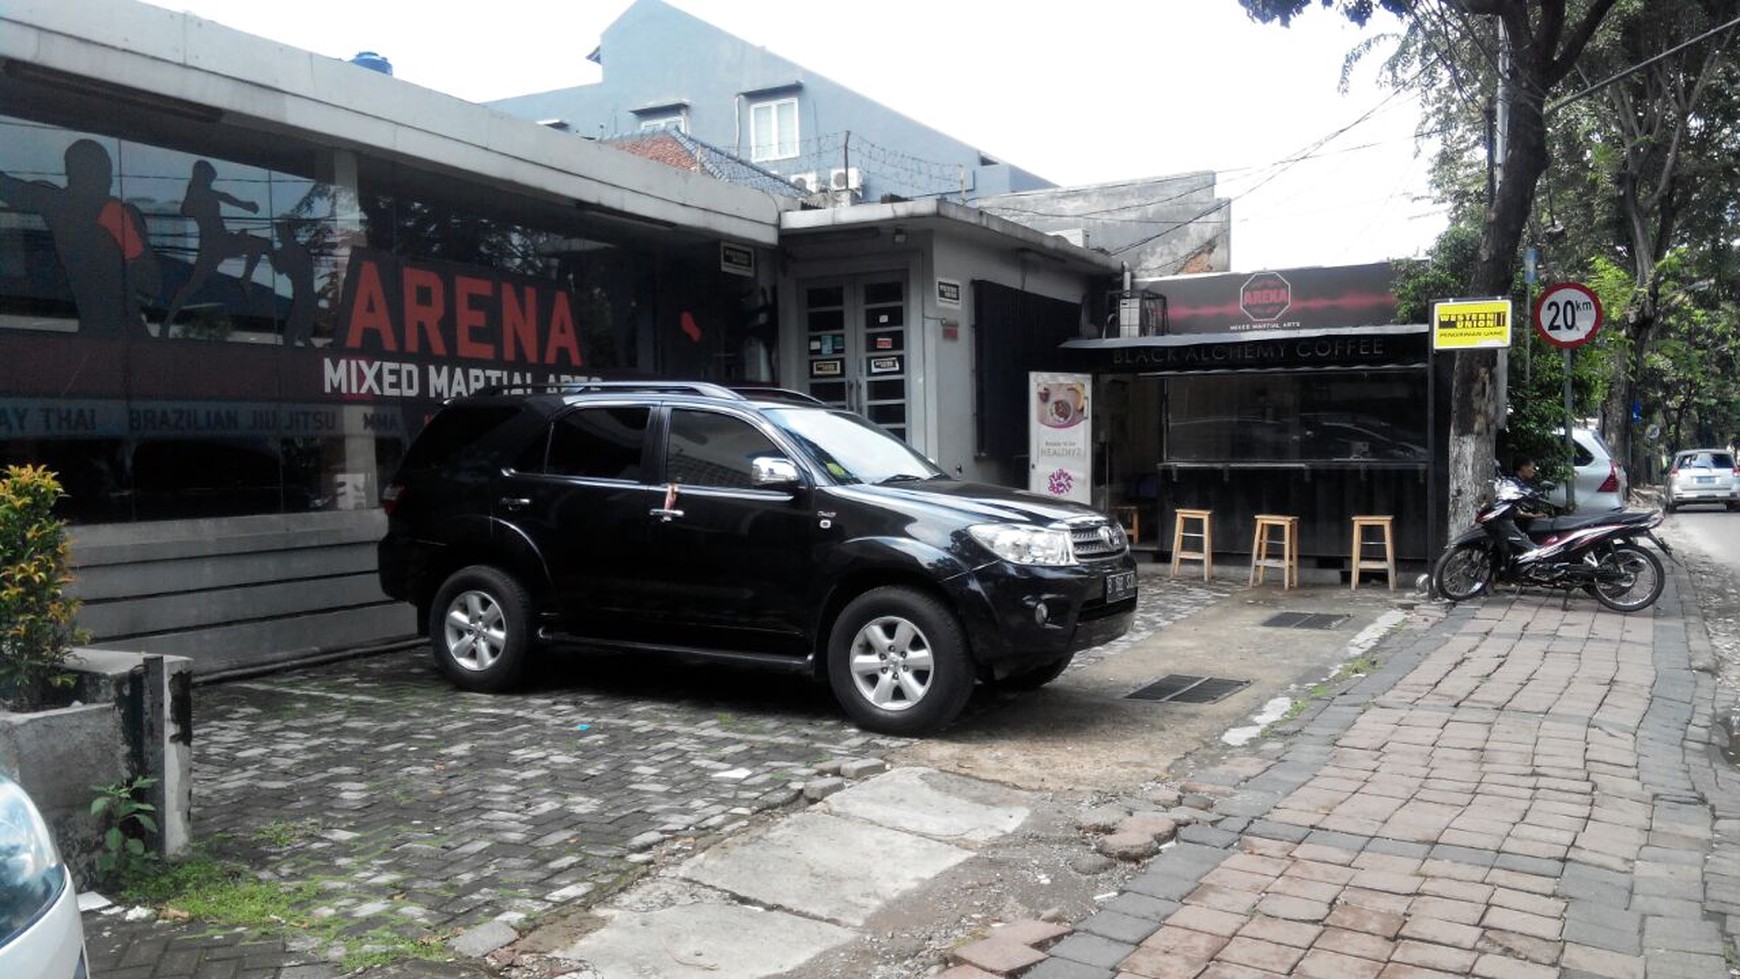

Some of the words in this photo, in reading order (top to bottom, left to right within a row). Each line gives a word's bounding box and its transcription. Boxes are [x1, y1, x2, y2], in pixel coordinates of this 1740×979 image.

[1243, 288, 1288, 306] ARENA
[346, 260, 583, 366] ARENA
[1440, 313, 1495, 322] WESTERN
[1456, 320, 1495, 329] UNION
[1547, 300, 1576, 331] 20
[1576, 299, 1593, 312] km
[1113, 349, 1178, 364] BLACK
[1184, 344, 1288, 362] ALCHEMY
[1295, 338, 1385, 358] COFFEE
[324, 358, 419, 398] MIXED
[39, 408, 97, 432] THAI
[128, 408, 239, 432] BRAZILIAN
[249, 409, 278, 432] JIU
[283, 411, 337, 432] JITSU
[362, 412, 399, 431] MMA
